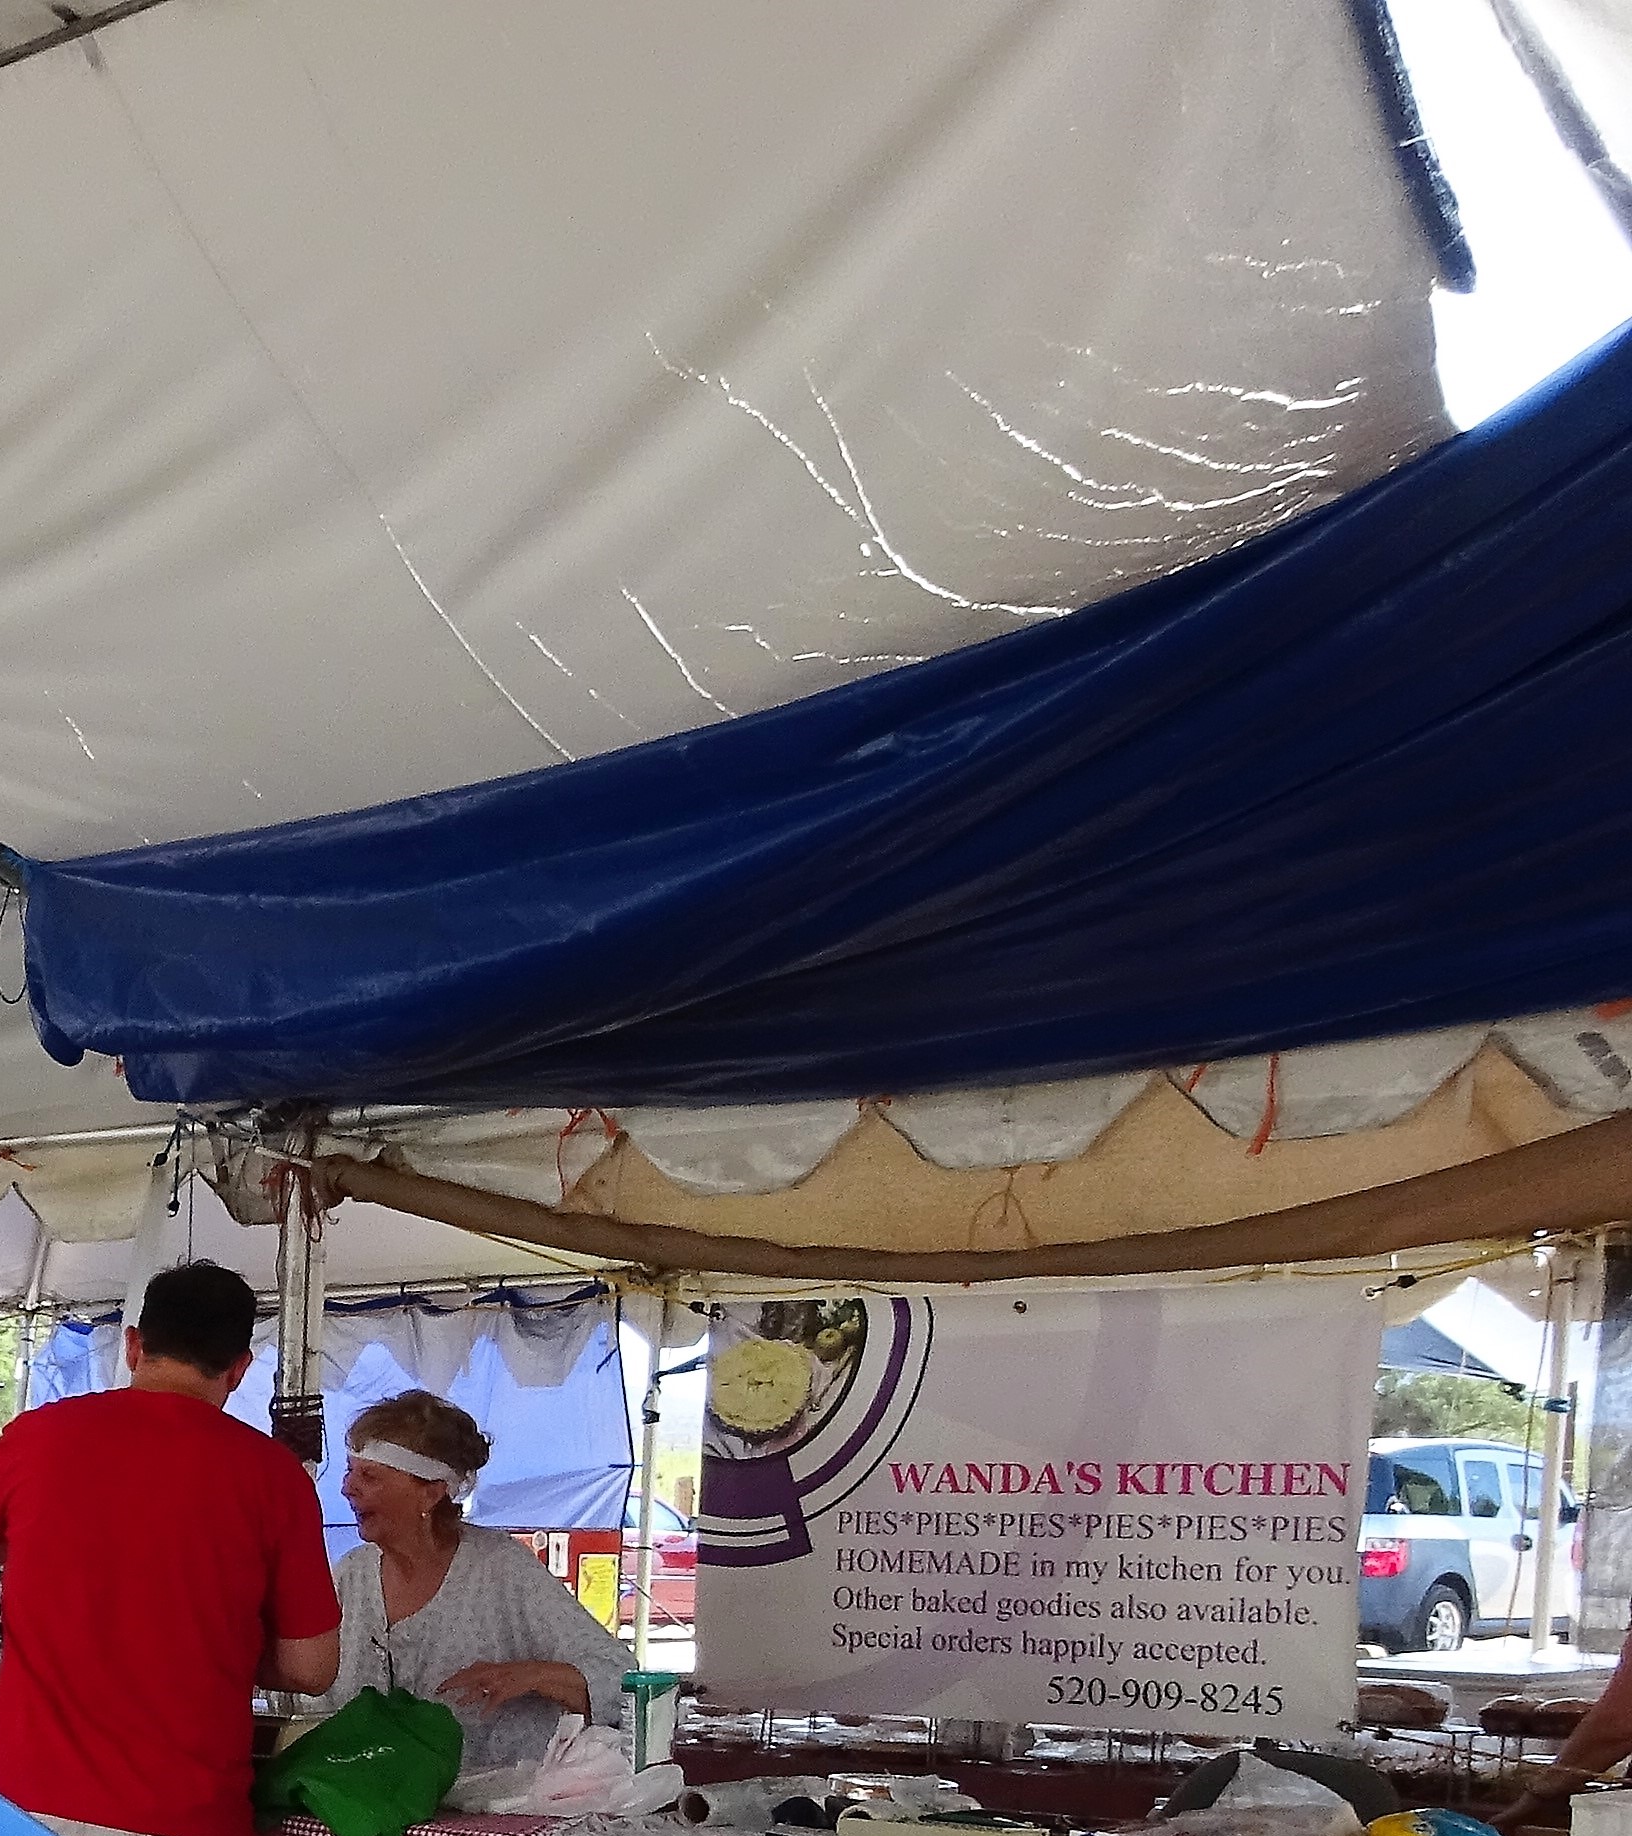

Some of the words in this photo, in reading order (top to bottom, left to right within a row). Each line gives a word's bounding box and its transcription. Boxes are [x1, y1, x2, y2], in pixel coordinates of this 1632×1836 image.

[888, 1461, 1102, 1495] WANDA'S
[1116, 1462, 1351, 1496] KITCHEN
[835, 1548, 1021, 1578] HOMEMADE
[1030, 1552, 1056, 1578] in
[1065, 1560, 1108, 1585] my
[1117, 1553, 1223, 1582] kitchen
[1235, 1556, 1278, 1583] for
[1286, 1563, 1351, 1590] you.
[832, 1586, 904, 1612] Other
[911, 1588, 987, 1615] baked
[995, 1592, 1102, 1623] goodies
[1111, 1594, 1167, 1621] also
[1177, 1597, 1318, 1626] available.
[831, 1623, 922, 1653] Special
[931, 1628, 1012, 1654] orders
[1022, 1630, 1124, 1665] happily
[1133, 1639, 1267, 1670] accepted.
[1047, 1675, 1284, 1717] 520-909-8245
